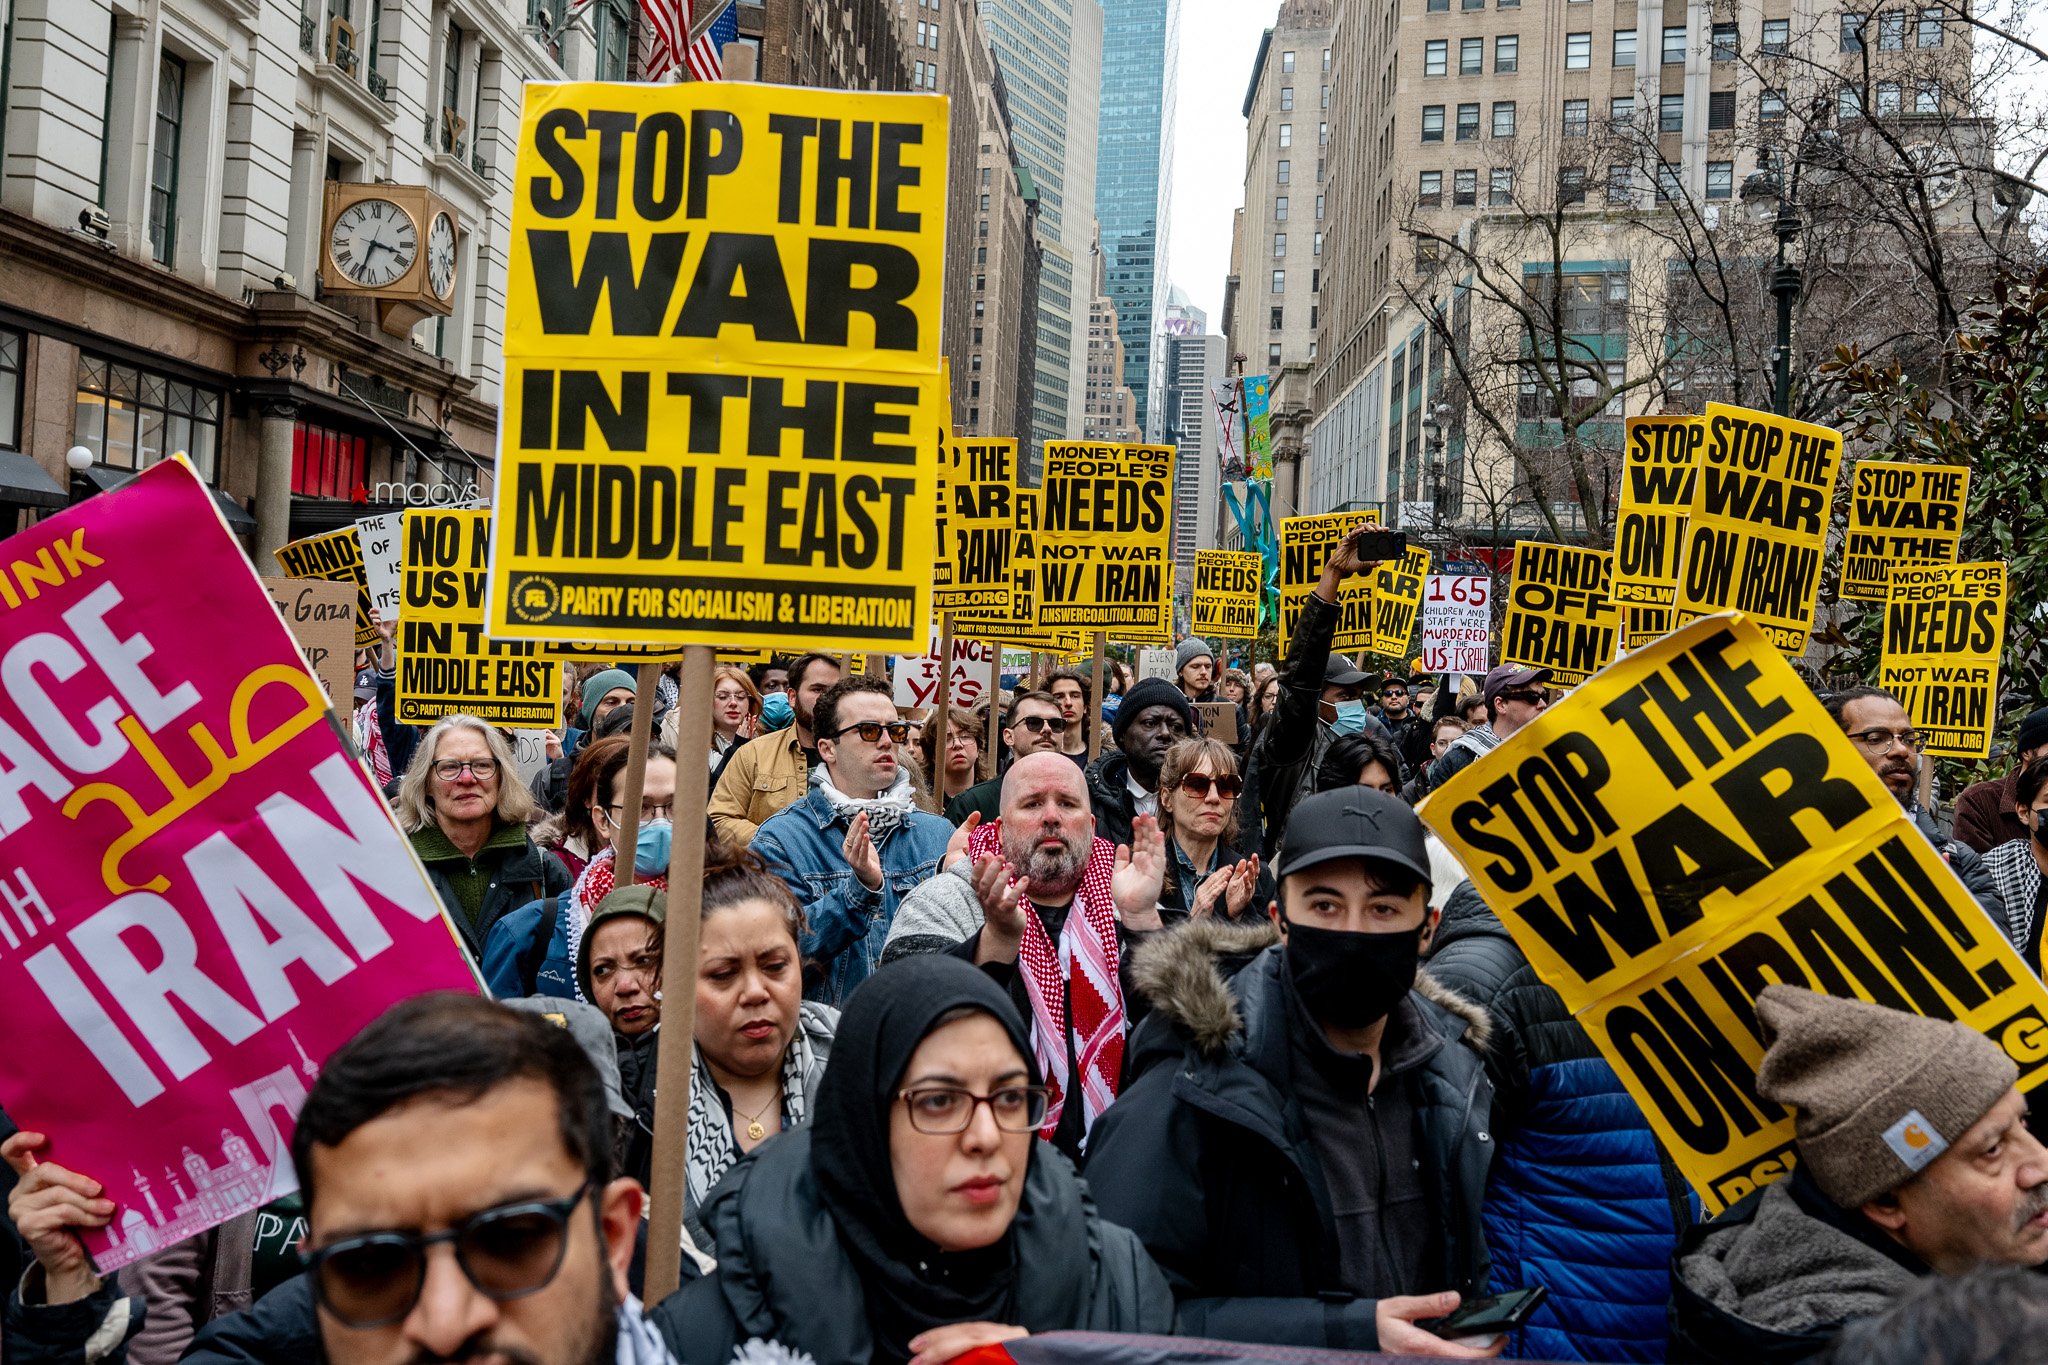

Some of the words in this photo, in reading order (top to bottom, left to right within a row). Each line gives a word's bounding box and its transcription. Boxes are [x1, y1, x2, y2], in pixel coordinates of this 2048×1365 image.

[529, 107, 744, 221] STOP
[769, 112, 924, 233] THE
[526, 229, 920, 352] WAR
[519, 368, 650, 453] IN
[666, 372, 920, 465] THE
[1050, 447, 1120, 460] MONEY
[1125, 449, 1169, 462] FOR
[1632, 424, 1704, 464] STOP
[1710, 415, 1783, 474] STOP
[1784, 431, 1836, 487] THE
[967, 446, 1010, 482] THE
[1048, 461, 1168, 478] PEOPLE'S
[955, 484, 1010, 519] AR
[1705, 466, 1824, 535] WAR
[1858, 468, 1916, 499] STOP
[1922, 472, 1962, 501] THE
[514, 462, 747, 564] MIDDLE
[763, 470, 915, 571] EAST
[1044, 478, 1165, 533] NEEDS
[1856, 499, 1958, 531] WAR
[360, 517, 385, 532] THE
[1285, 518, 1343, 531] MONEY
[1346, 515, 1375, 527] FOR
[282, 531, 364, 577] HANDS
[371, 539, 390, 555] OF
[408, 515, 460, 568] NO
[957, 528, 1012, 584] RAN!
[1042, 545, 1094, 560] NOT
[1101, 546, 1161, 561] WAR
[1620, 513, 1666, 578] ON
[1849, 534, 1885, 556] IN
[1889, 537, 1953, 559] THE
[1197, 566, 1257, 593] NEEDS
[1198, 559, 1258, 568] PEOPLE'S
[1518, 546, 1613, 592] HANDS
[1686, 527, 1739, 607] ON
[1737, 536, 1818, 622] IRAN!
[1893, 569, 1958, 584] MONEY
[1961, 568, 2001, 581] FOR
[406, 571, 459, 609] US
[1042, 562, 1084, 602] W/
[1094, 562, 1160, 602] IRAN
[1377, 570, 1419, 600] AR
[1428, 576, 1488, 606] 165
[1892, 583, 2001, 600] PEOPLE'S
[295, 588, 350, 622] Gaza
[561, 586, 623, 616] PARTY
[627, 587, 663, 617] FOR
[667, 589, 775, 622] SOCIALISM
[778, 596, 795, 624] &
[799, 596, 911, 628] LIBERATION
[1041, 607, 1158, 623] ANSWERCOALITION.ORG
[1196, 596, 1223, 604] NOT
[1226, 598, 1255, 606] WAR
[1196, 604, 1217, 622] W/
[1222, 606, 1255, 625] IRAN
[1285, 593, 1311, 606] NO
[1425, 606, 1463, 615] CHILDREN
[1466, 609, 1484, 618] AND
[1515, 584, 1616, 620] OFF
[404, 622, 452, 654] IN
[958, 624, 974, 634] PARTY
[976, 625, 986, 634] FOR
[987, 625, 1014, 635] SOCIALISM
[1015, 626, 1020, 635] &
[1424, 629, 1487, 641] MURDERED
[1428, 617, 1455, 626] STAFF
[1460, 618, 1486, 628] WERE
[1888, 600, 1997, 655] NEEDS
[1150, 652, 1174, 664] EVERY
[1442, 640, 1451, 648] BY
[1507, 613, 1614, 672] IRAN!
[402, 657, 489, 695] MIDDLE
[496, 660, 554, 697] EAST
[1885, 668, 1927, 682] NOT
[1932, 668, 1989, 683] WAR
[420, 704, 443, 715] PARTY
[444, 705, 458, 716] FOR
[460, 705, 499, 718] SOCIALISM
[502, 708, 508, 717] &
[510, 707, 553, 719] LIBERATION
[1922, 685, 1988, 727] IRAN
[1451, 731, 1620, 894] STOP
[1601, 629, 1794, 790] THE
[1513, 732, 1873, 984] WAR
[23, 753, 442, 1108] IRAN
[1605, 976, 1788, 1156] ON
